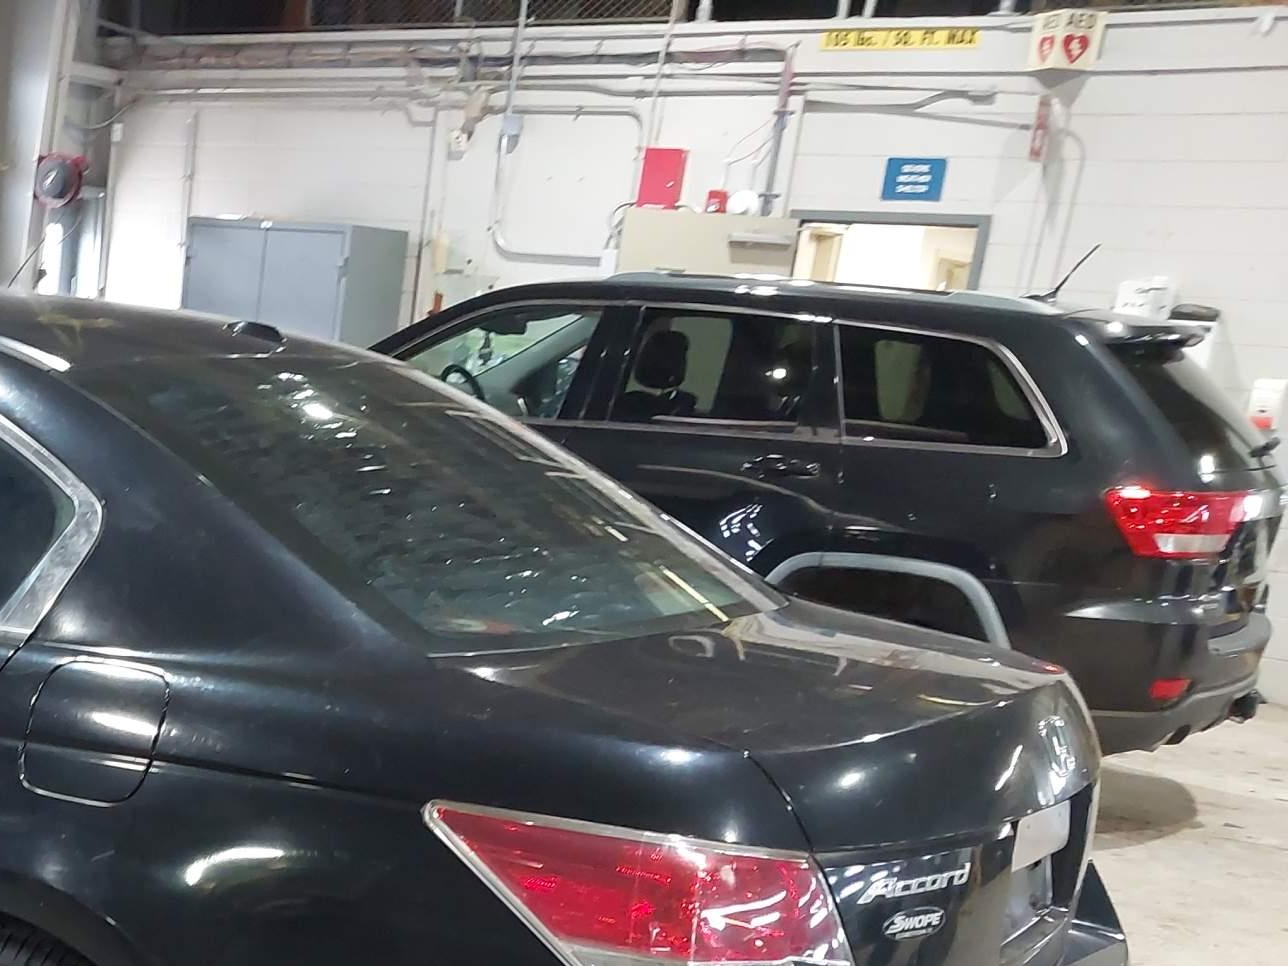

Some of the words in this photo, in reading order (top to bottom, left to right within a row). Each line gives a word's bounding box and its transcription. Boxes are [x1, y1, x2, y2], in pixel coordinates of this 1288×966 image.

[1065, 12, 1098, 29] AED
[856, 862, 972, 905] Accord
[885, 912, 943, 935] SWOPE
